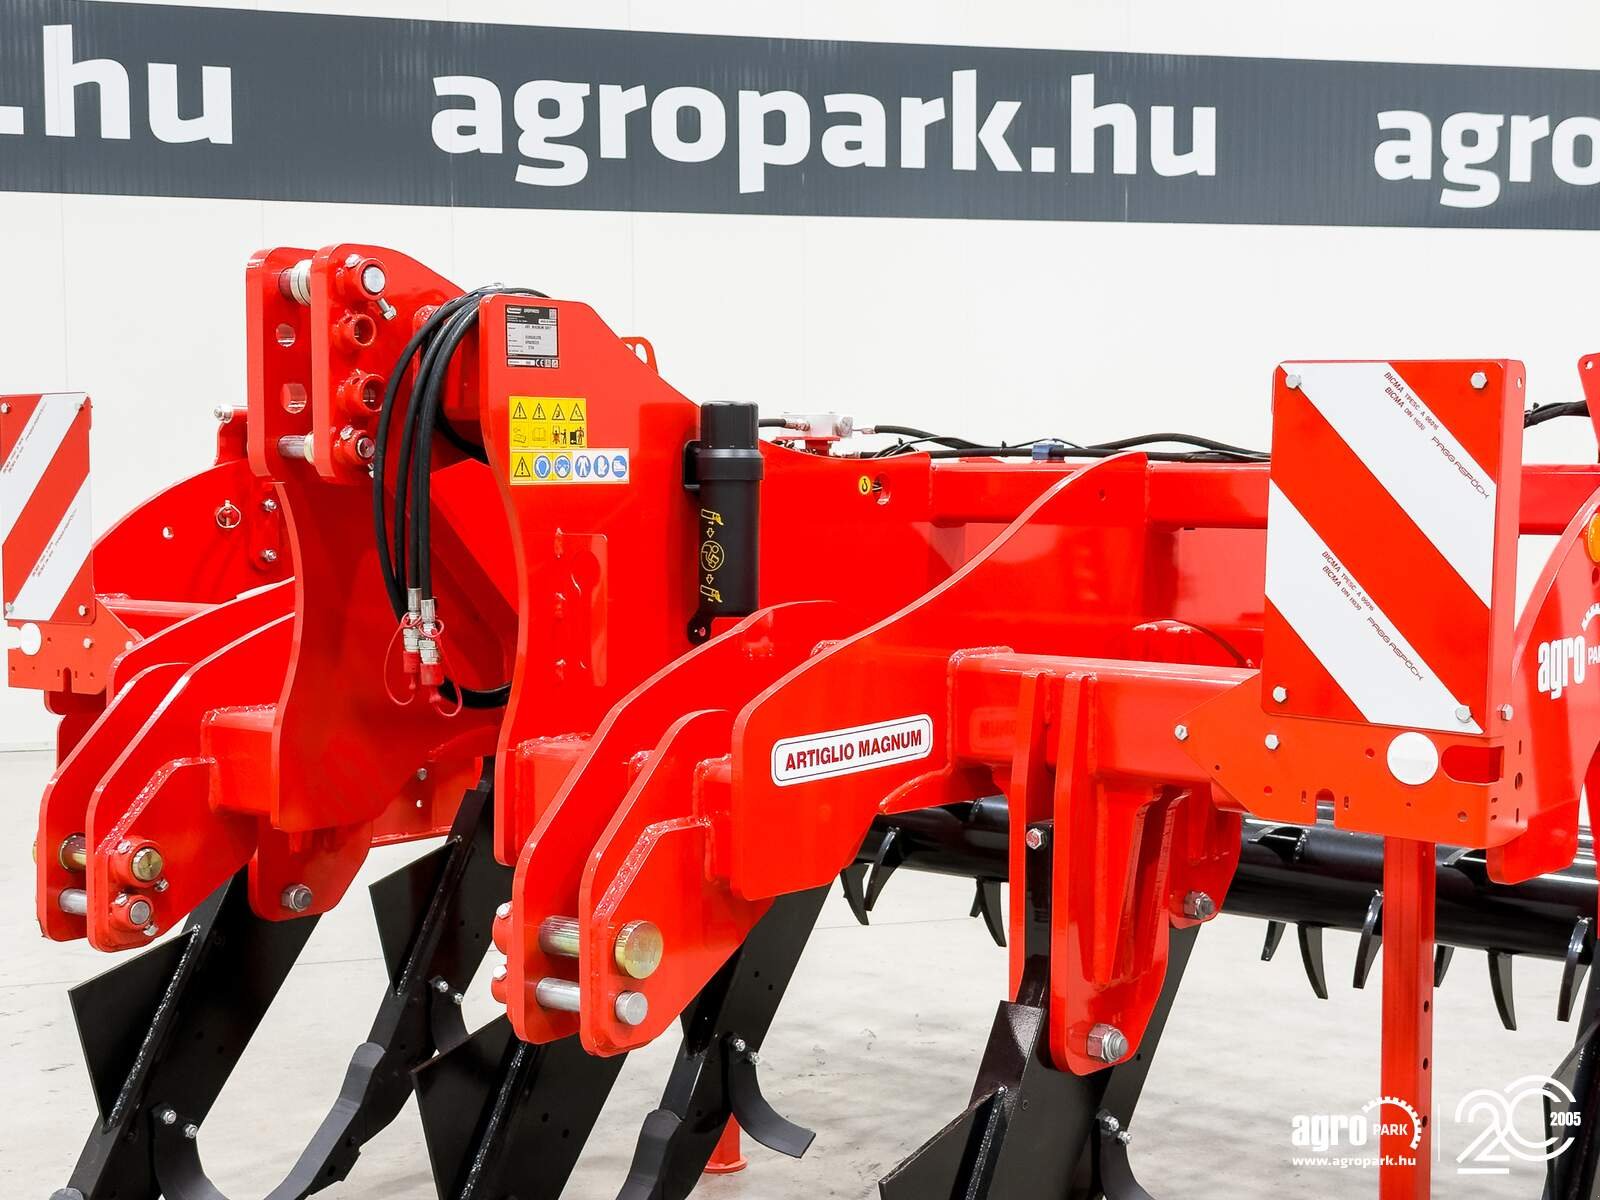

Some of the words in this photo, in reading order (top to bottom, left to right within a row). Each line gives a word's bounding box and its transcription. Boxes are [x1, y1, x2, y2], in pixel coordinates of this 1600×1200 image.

[0, 25, 233, 145] .hu
[431, 69, 1217, 194] agropark.hu
[1374, 110, 1600, 208] agro
[1383, 371, 1404, 393] BICMA
[1384, 386, 1404, 407] BICMA
[1321, 550, 1341, 572] BICMA
[1321, 565, 1341, 587] BICMA
[1538, 635, 1585, 700] agro
[785, 742, 854, 771] ARTIGLIO
[858, 729, 922, 758] MAGNUM
